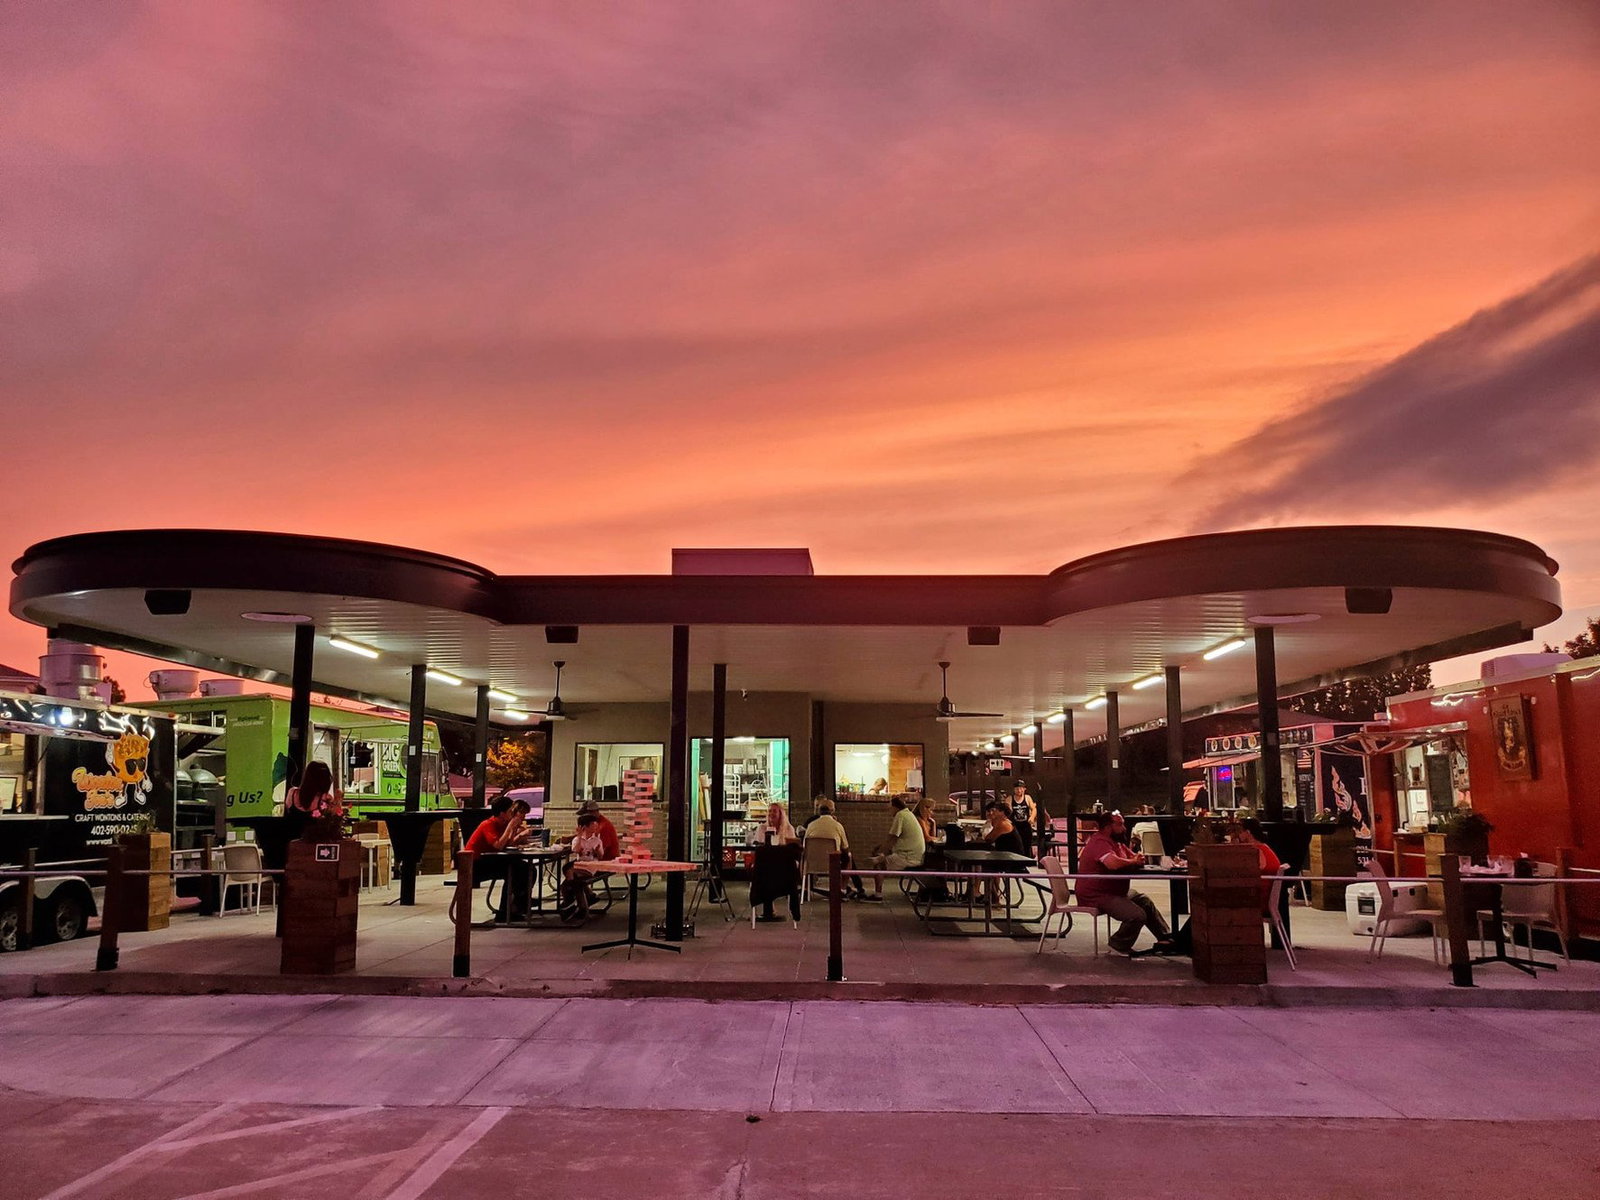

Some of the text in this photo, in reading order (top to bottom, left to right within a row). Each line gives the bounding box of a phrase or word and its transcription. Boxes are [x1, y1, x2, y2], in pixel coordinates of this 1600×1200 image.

[382, 743, 400, 761] BIG
[239, 791, 263, 803] Us?
[74, 814, 94, 822] CRAFT
